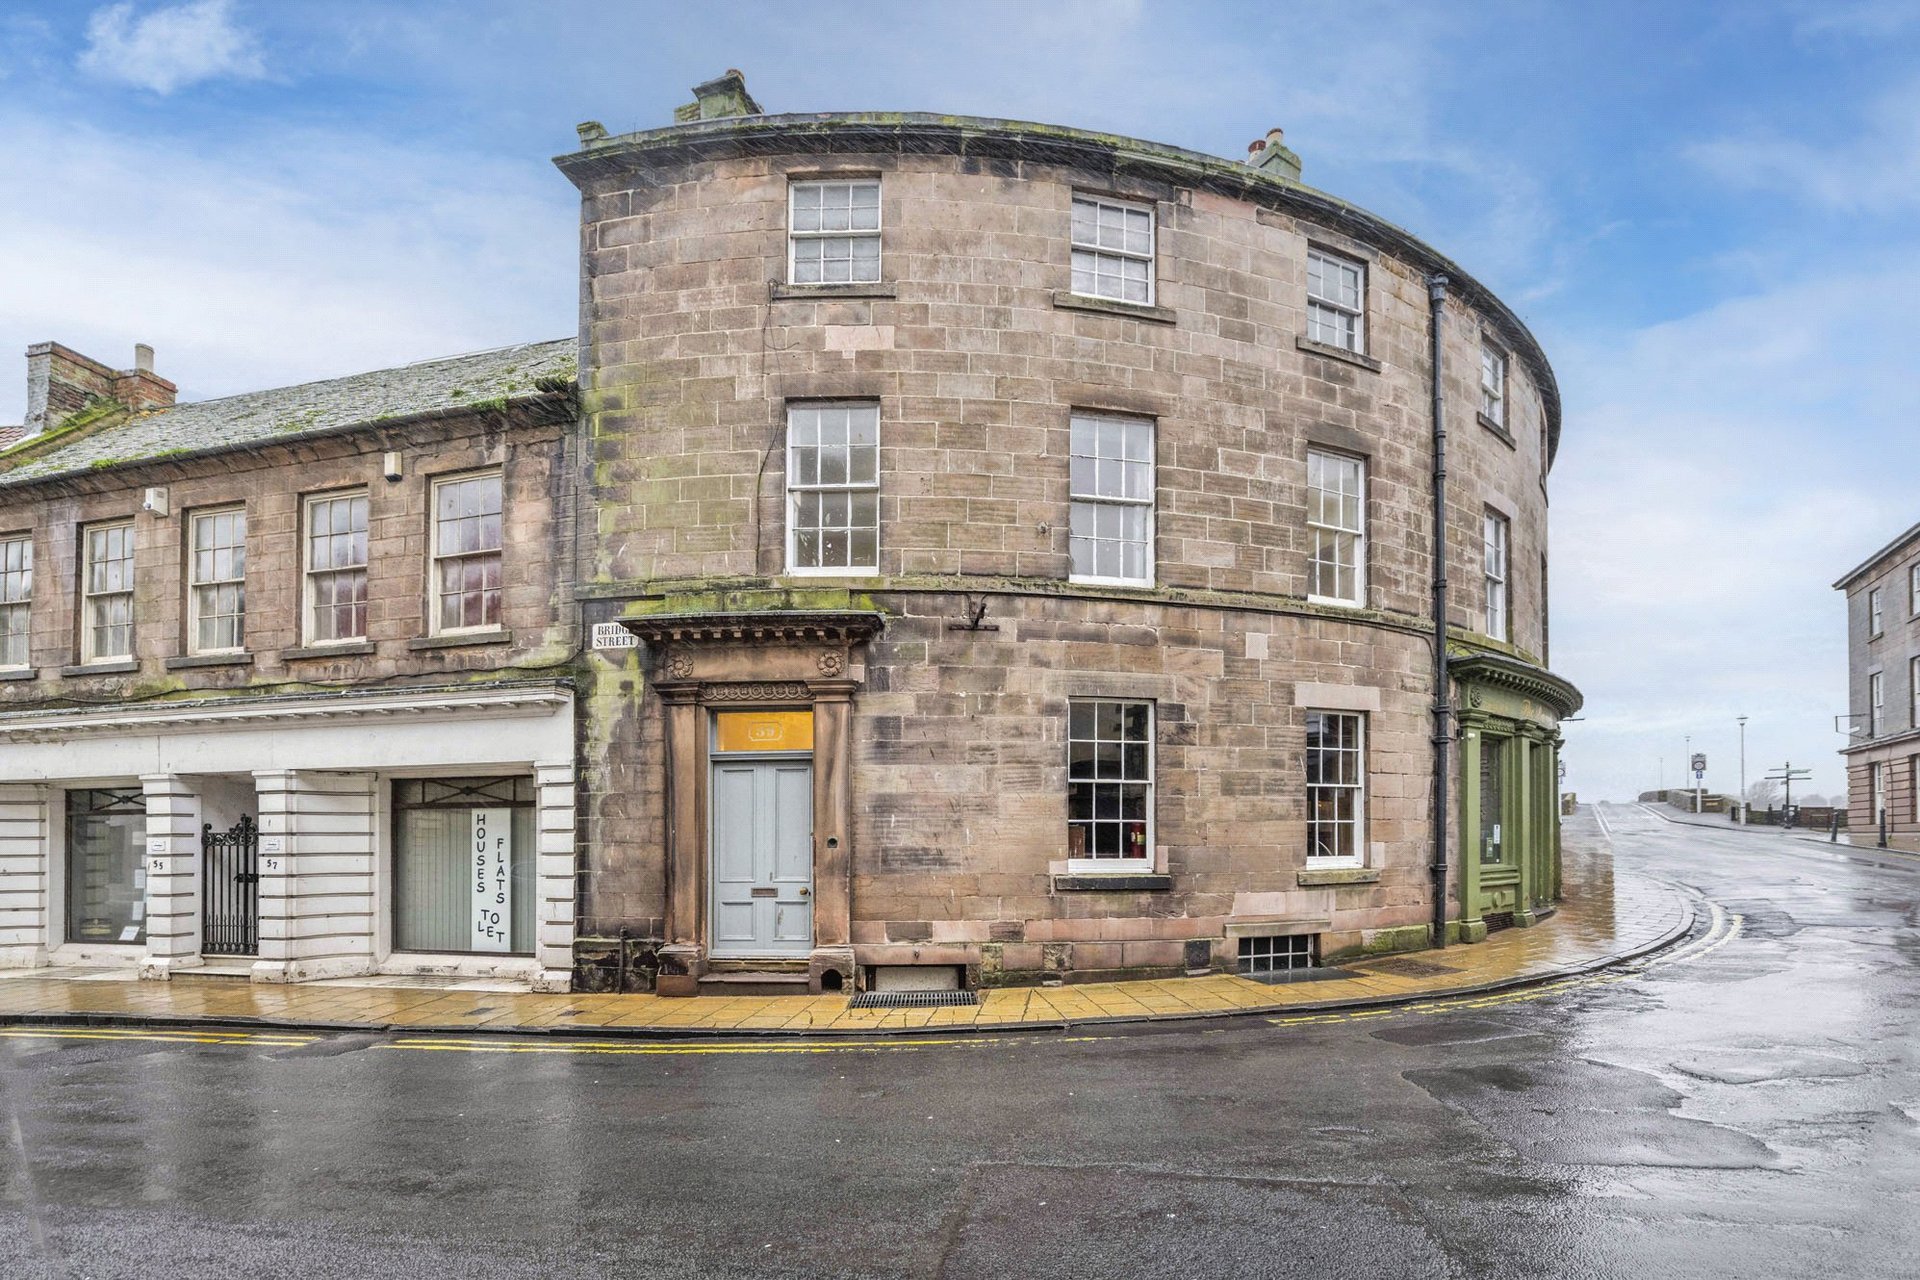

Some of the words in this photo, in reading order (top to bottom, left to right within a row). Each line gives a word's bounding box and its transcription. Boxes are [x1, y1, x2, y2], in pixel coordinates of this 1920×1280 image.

[598, 625, 629, 635] BRIDG
[596, 636, 634, 646] STREET
[476, 814, 486, 893] HOUSES
[153, 860, 164, 870] 55
[267, 859, 278, 870] 57
[495, 838, 505, 904] FLATS
[481, 909, 500, 925] TO
[478, 921, 505, 943] LET
